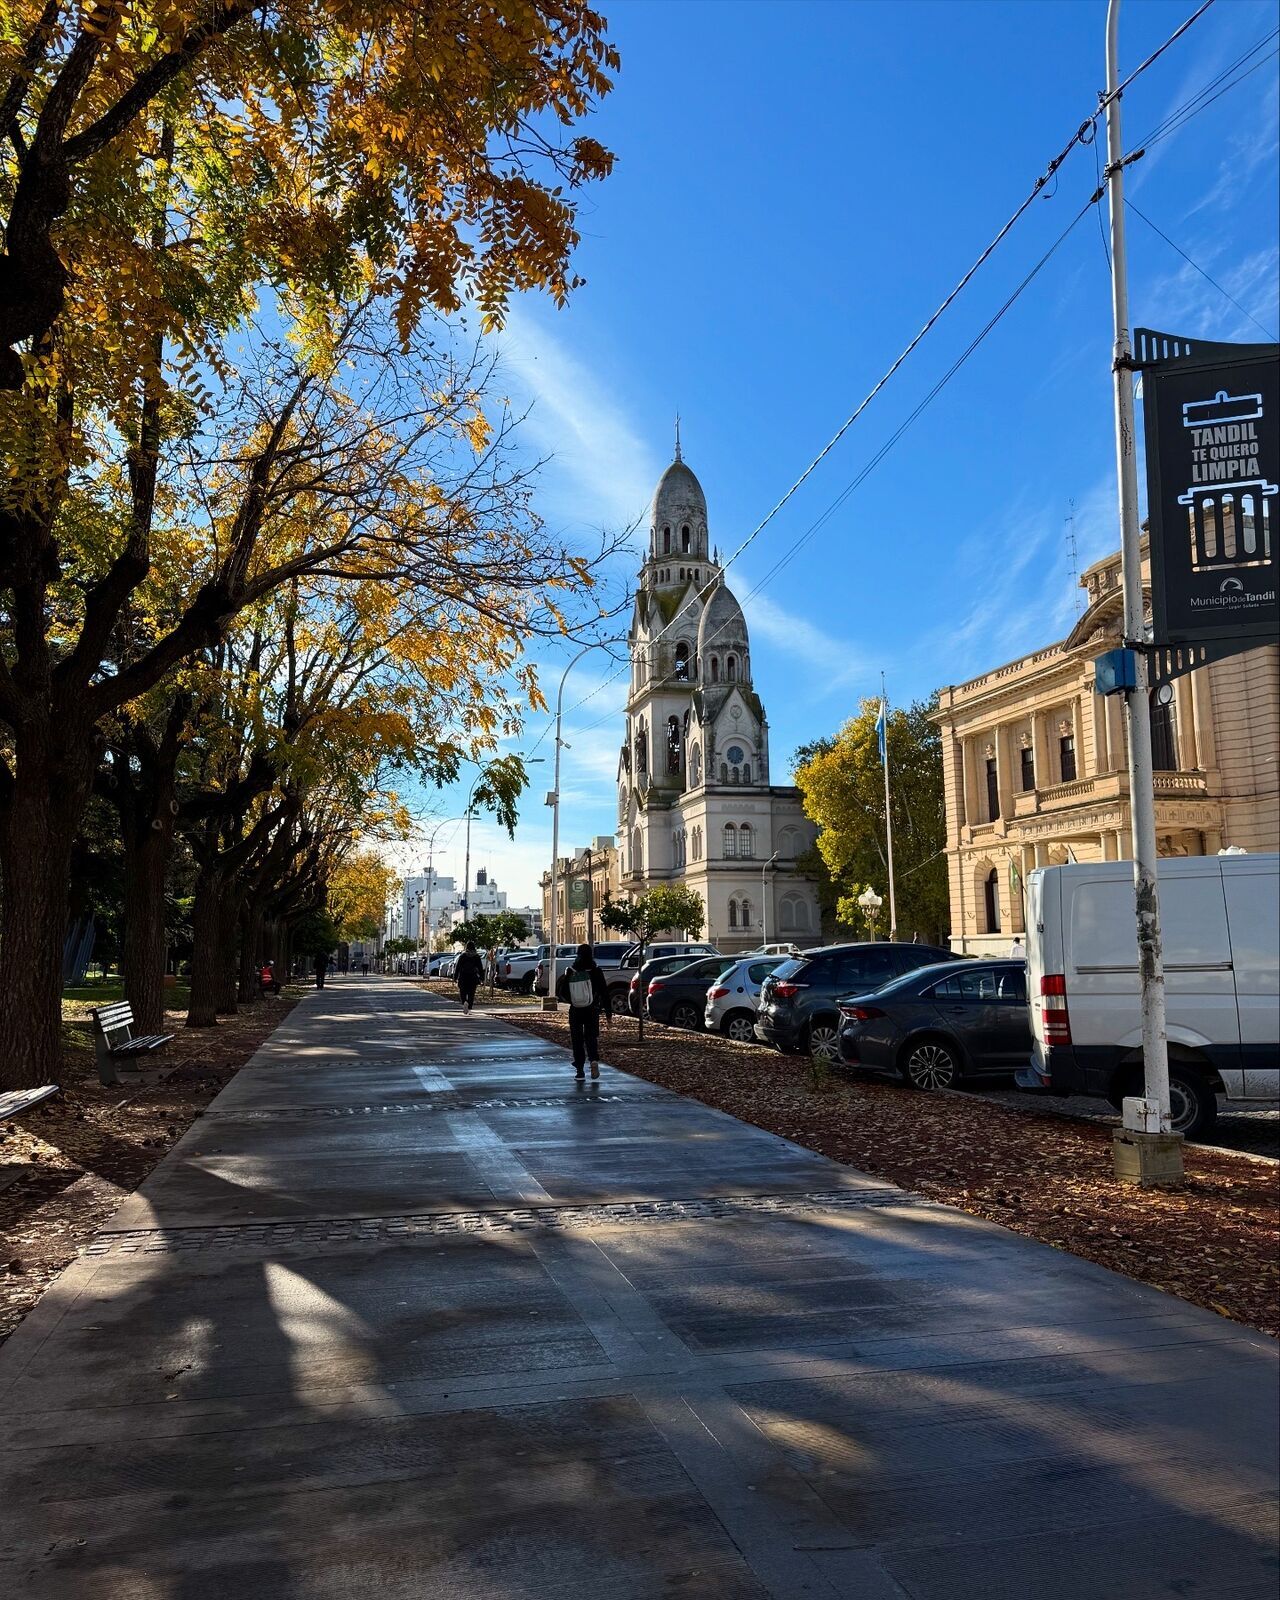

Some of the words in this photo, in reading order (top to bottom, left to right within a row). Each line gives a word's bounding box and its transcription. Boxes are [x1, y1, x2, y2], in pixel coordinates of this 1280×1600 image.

[1190, 422, 1258, 446] TANDIL
[1192, 448, 1207, 462] TE
[1210, 442, 1258, 460] QUIERO
[1192, 458, 1260, 482] LIMPIA
[1190, 594, 1238, 606] Municipio
[1245, 590, 1275, 602] Tandil
